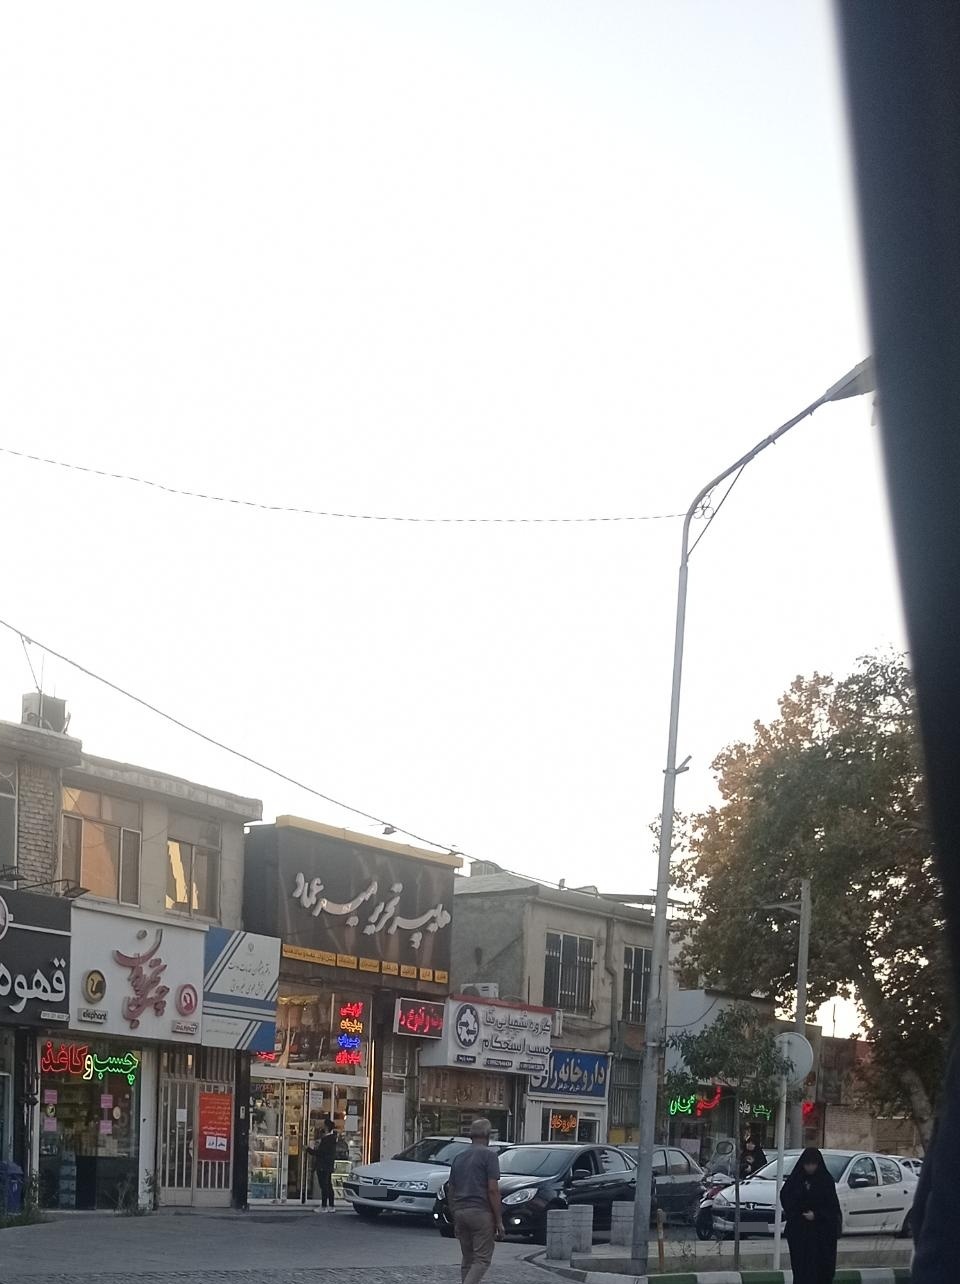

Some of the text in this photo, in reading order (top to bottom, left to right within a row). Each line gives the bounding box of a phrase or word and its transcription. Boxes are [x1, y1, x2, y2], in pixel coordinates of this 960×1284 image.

[41, 1041, 139, 1086] چسب و کاغذ
